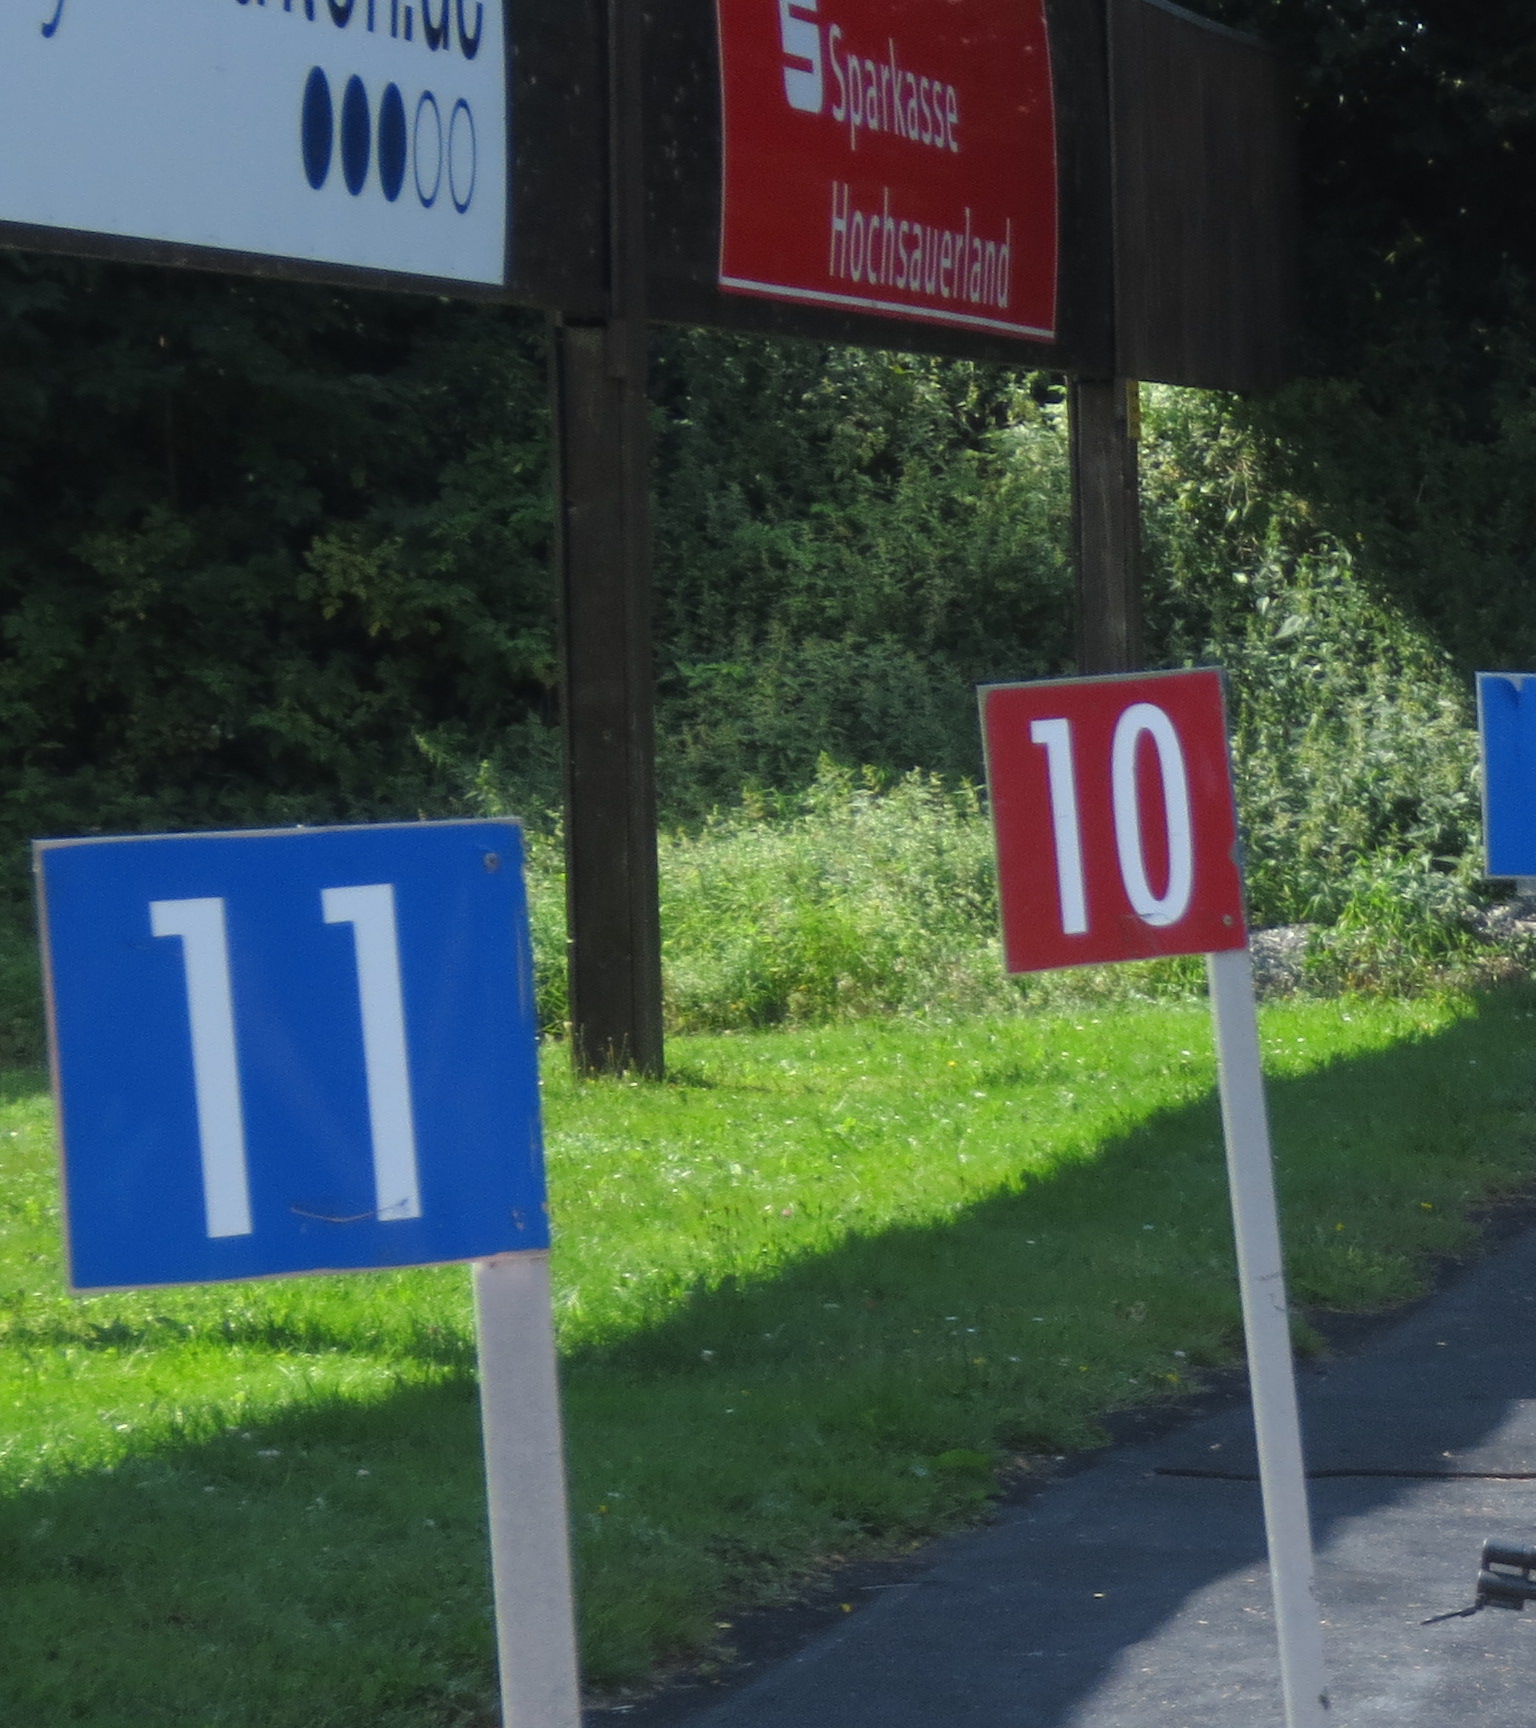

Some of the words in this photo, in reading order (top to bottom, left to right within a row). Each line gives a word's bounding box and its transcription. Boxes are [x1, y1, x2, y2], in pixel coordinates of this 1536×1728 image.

[829, 23, 959, 152] Sparkasse
[829, 180, 1010, 308] Hochsauerland
[1030, 702, 1194, 936] 10
[149, 883, 421, 1238] 11
